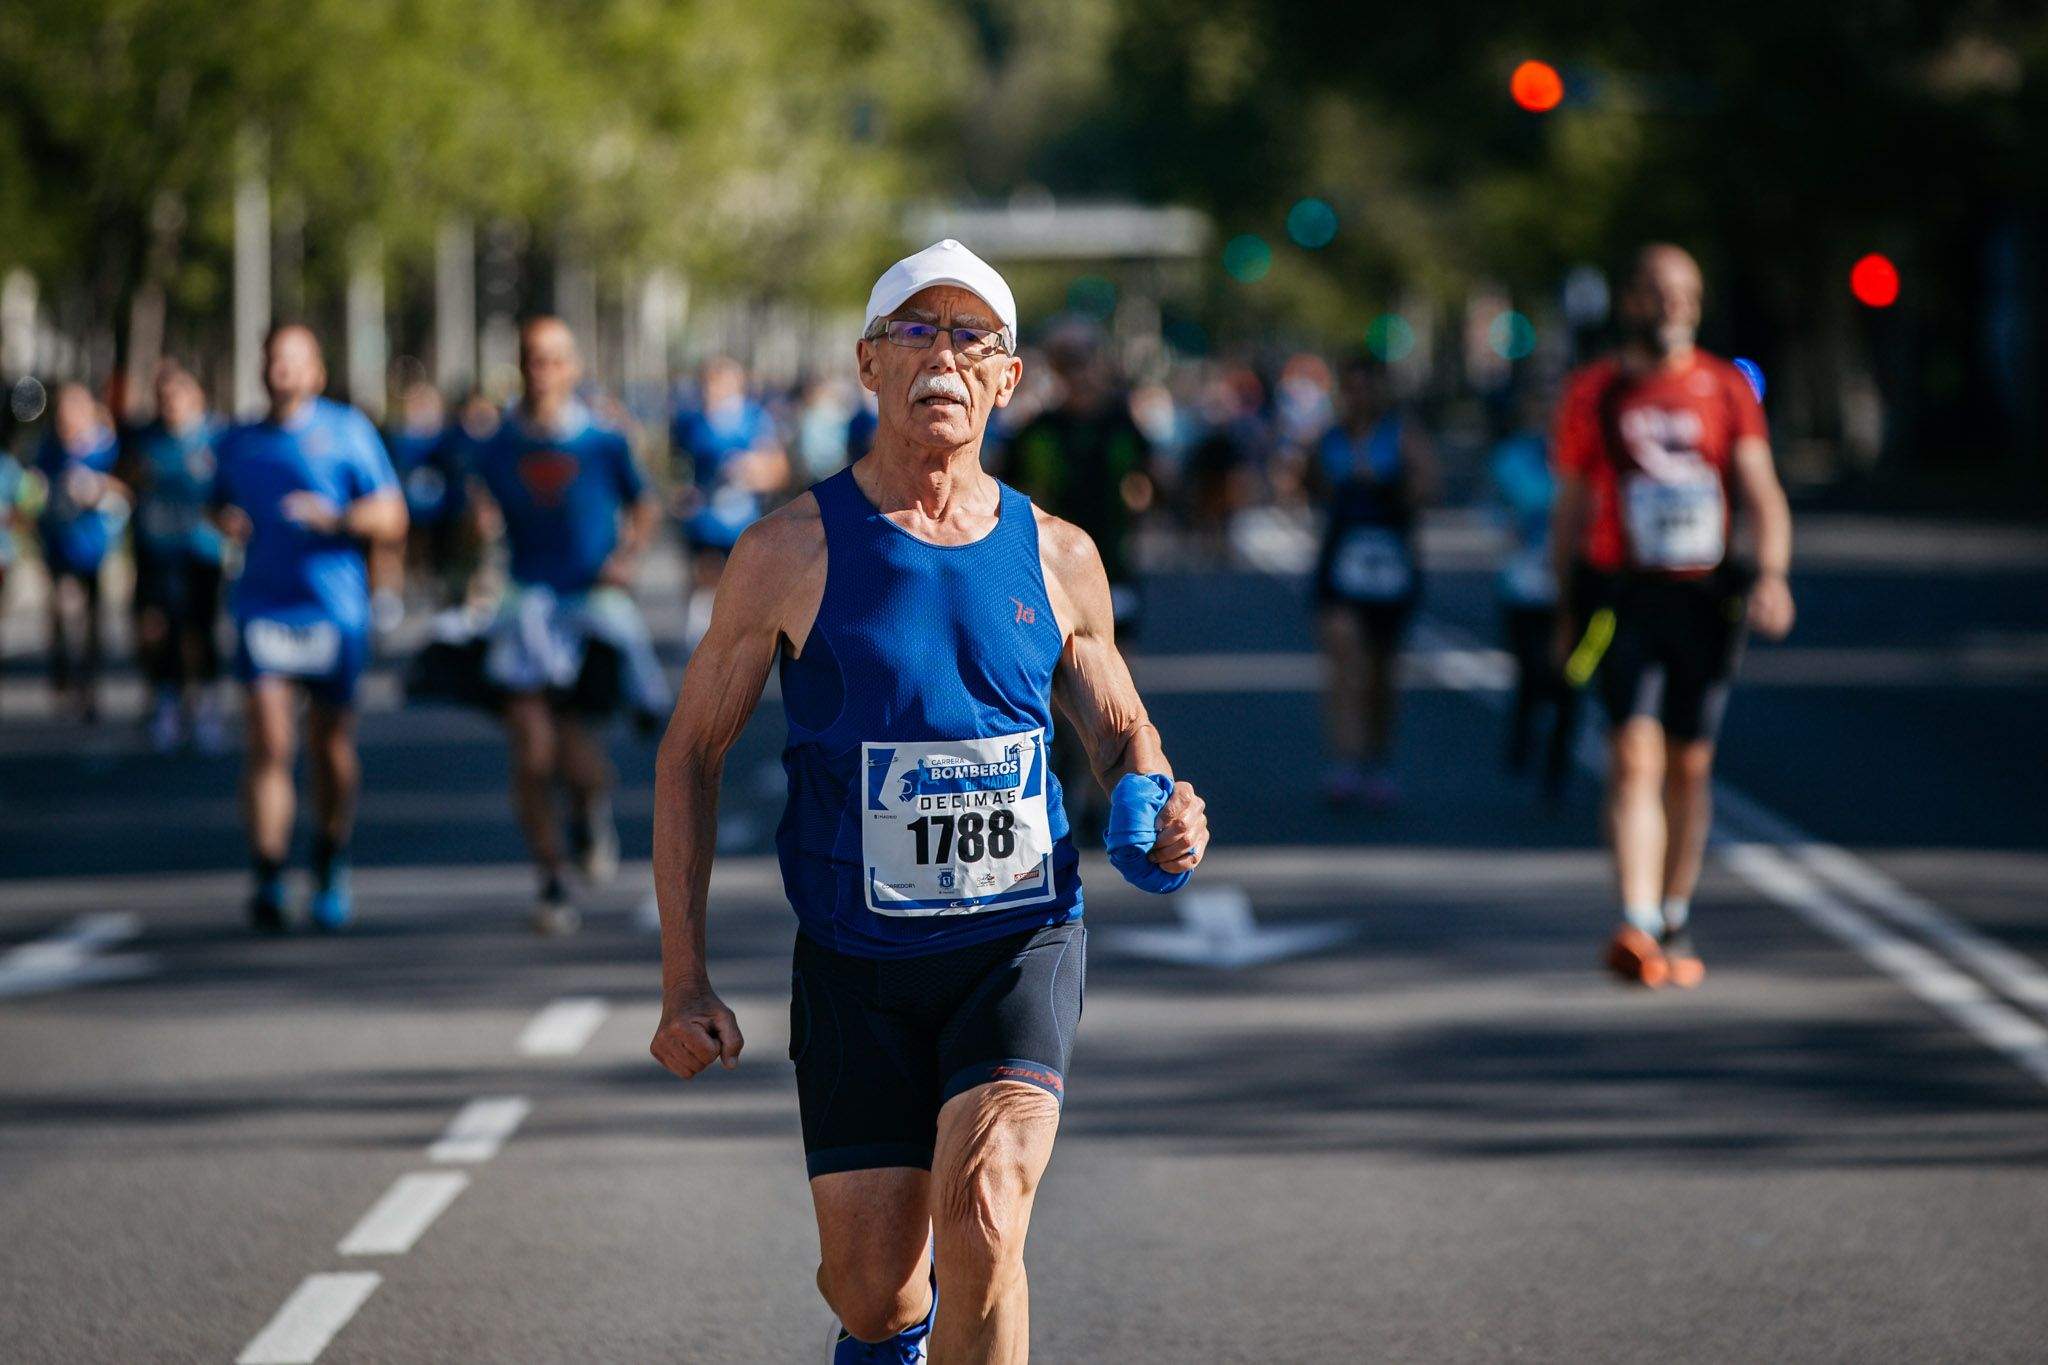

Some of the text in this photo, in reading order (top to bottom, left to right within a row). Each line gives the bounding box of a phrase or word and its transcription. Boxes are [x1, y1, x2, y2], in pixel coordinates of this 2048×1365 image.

[931, 757, 965, 766] CARRERA
[931, 761, 1019, 780] BOMBEROS
[982, 774, 1019, 789] MADRID
[920, 790, 1016, 810] DECIMAS
[907, 809, 1015, 865] 1788
